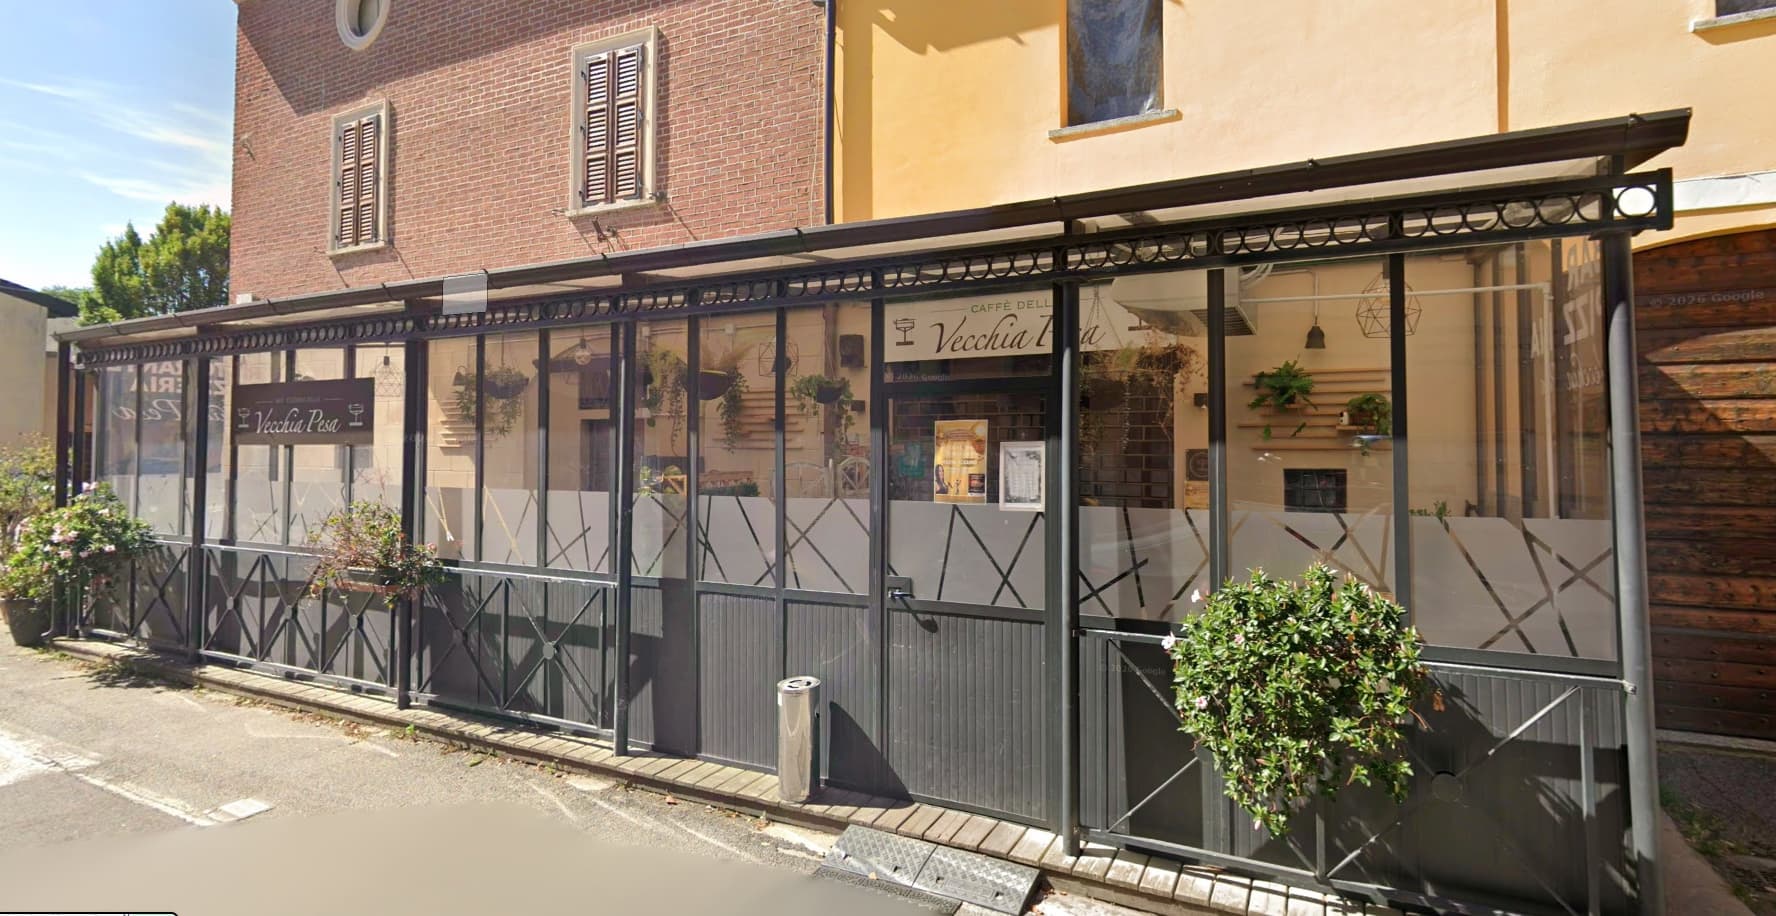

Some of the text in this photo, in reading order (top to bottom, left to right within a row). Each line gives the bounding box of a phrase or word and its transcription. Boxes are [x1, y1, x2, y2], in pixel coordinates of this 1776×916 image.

[971, 298, 1053, 313] CAFFÈ DELL
[930, 313, 1034, 354] Vecchia
[254, 407, 306, 434] Vecchia
[307, 409, 341, 433] Pesa
